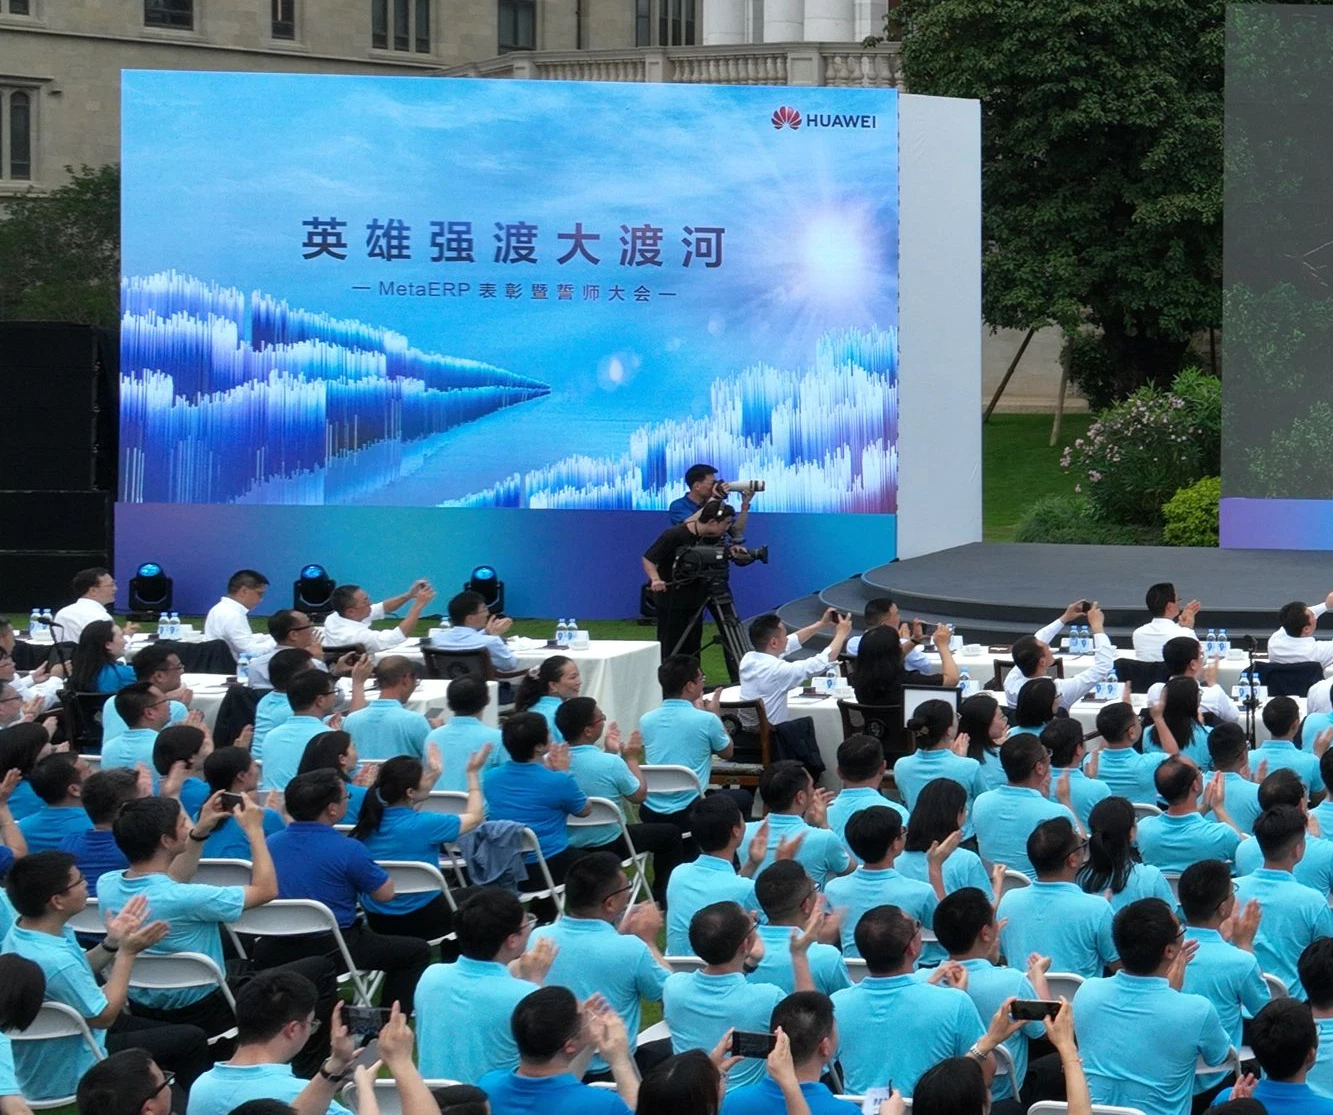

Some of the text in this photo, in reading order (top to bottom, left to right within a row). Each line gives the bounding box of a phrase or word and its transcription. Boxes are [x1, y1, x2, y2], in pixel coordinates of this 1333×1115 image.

[807, 114, 876, 129] HUAWEI
[302, 216, 725, 269] 英雄强渡大渡河
[378, 281, 471, 297] MetaERP
